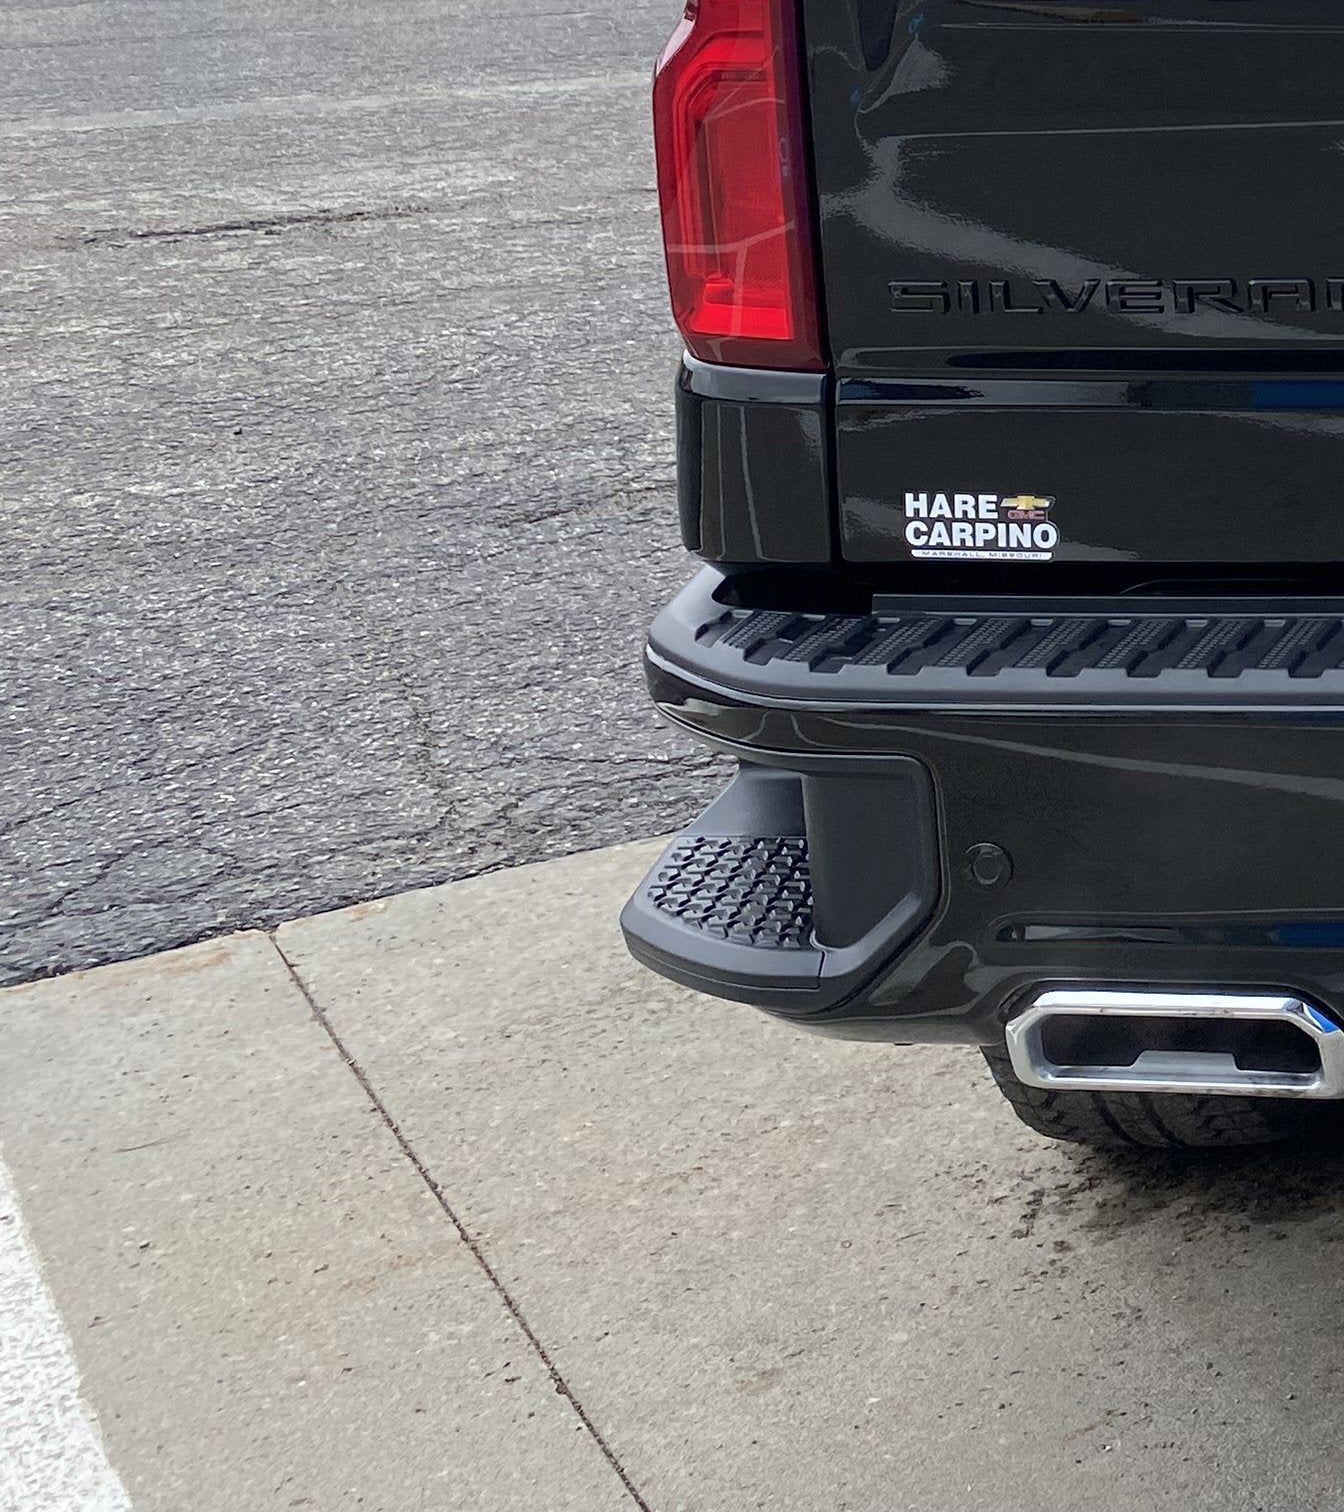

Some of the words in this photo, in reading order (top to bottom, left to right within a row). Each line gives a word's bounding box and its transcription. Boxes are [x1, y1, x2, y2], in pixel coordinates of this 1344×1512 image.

[904, 492, 998, 519] HARE
[1008, 510, 1045, 520] GMC
[905, 521, 1058, 549] CARPINO
